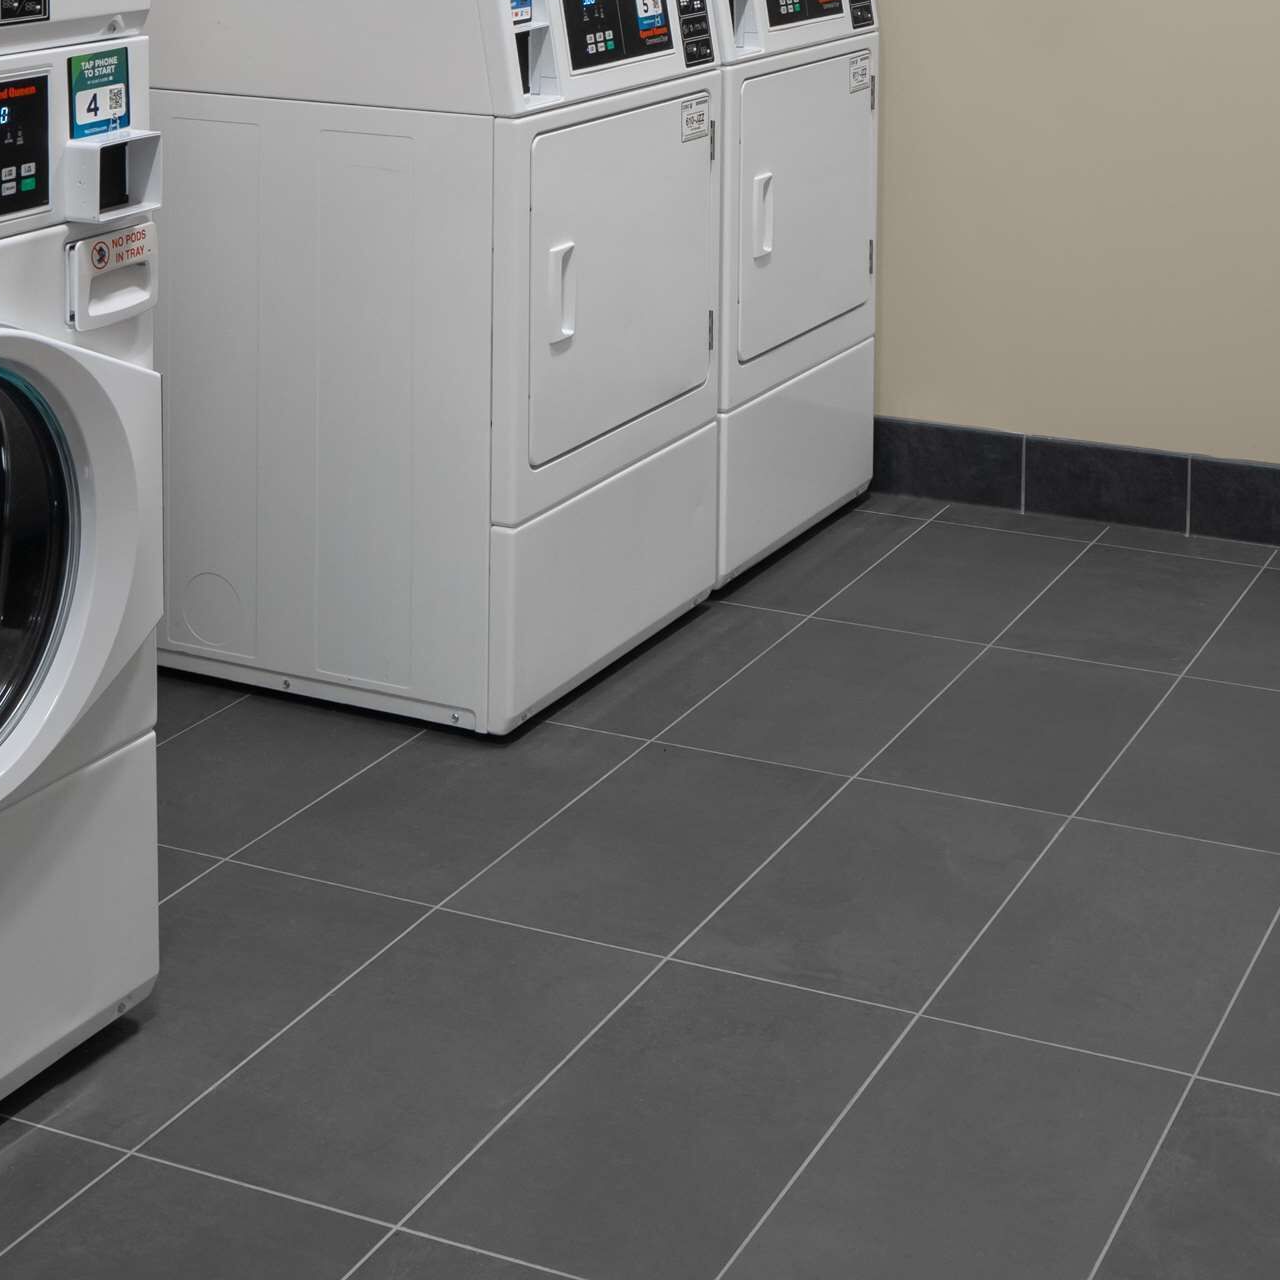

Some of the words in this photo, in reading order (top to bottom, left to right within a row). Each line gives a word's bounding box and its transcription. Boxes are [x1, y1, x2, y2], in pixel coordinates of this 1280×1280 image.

[81, 62, 94, 70] TAP
[95, 56, 118, 68] PHONE
[84, 70, 94, 78] TO
[94, 65, 115, 76] START
[86, 93, 99, 117] 4
[112, 236, 124, 248] NO
[126, 229, 146, 245] PODS
[115, 253, 124, 263] IN
[125, 245, 145, 259] TRAY
